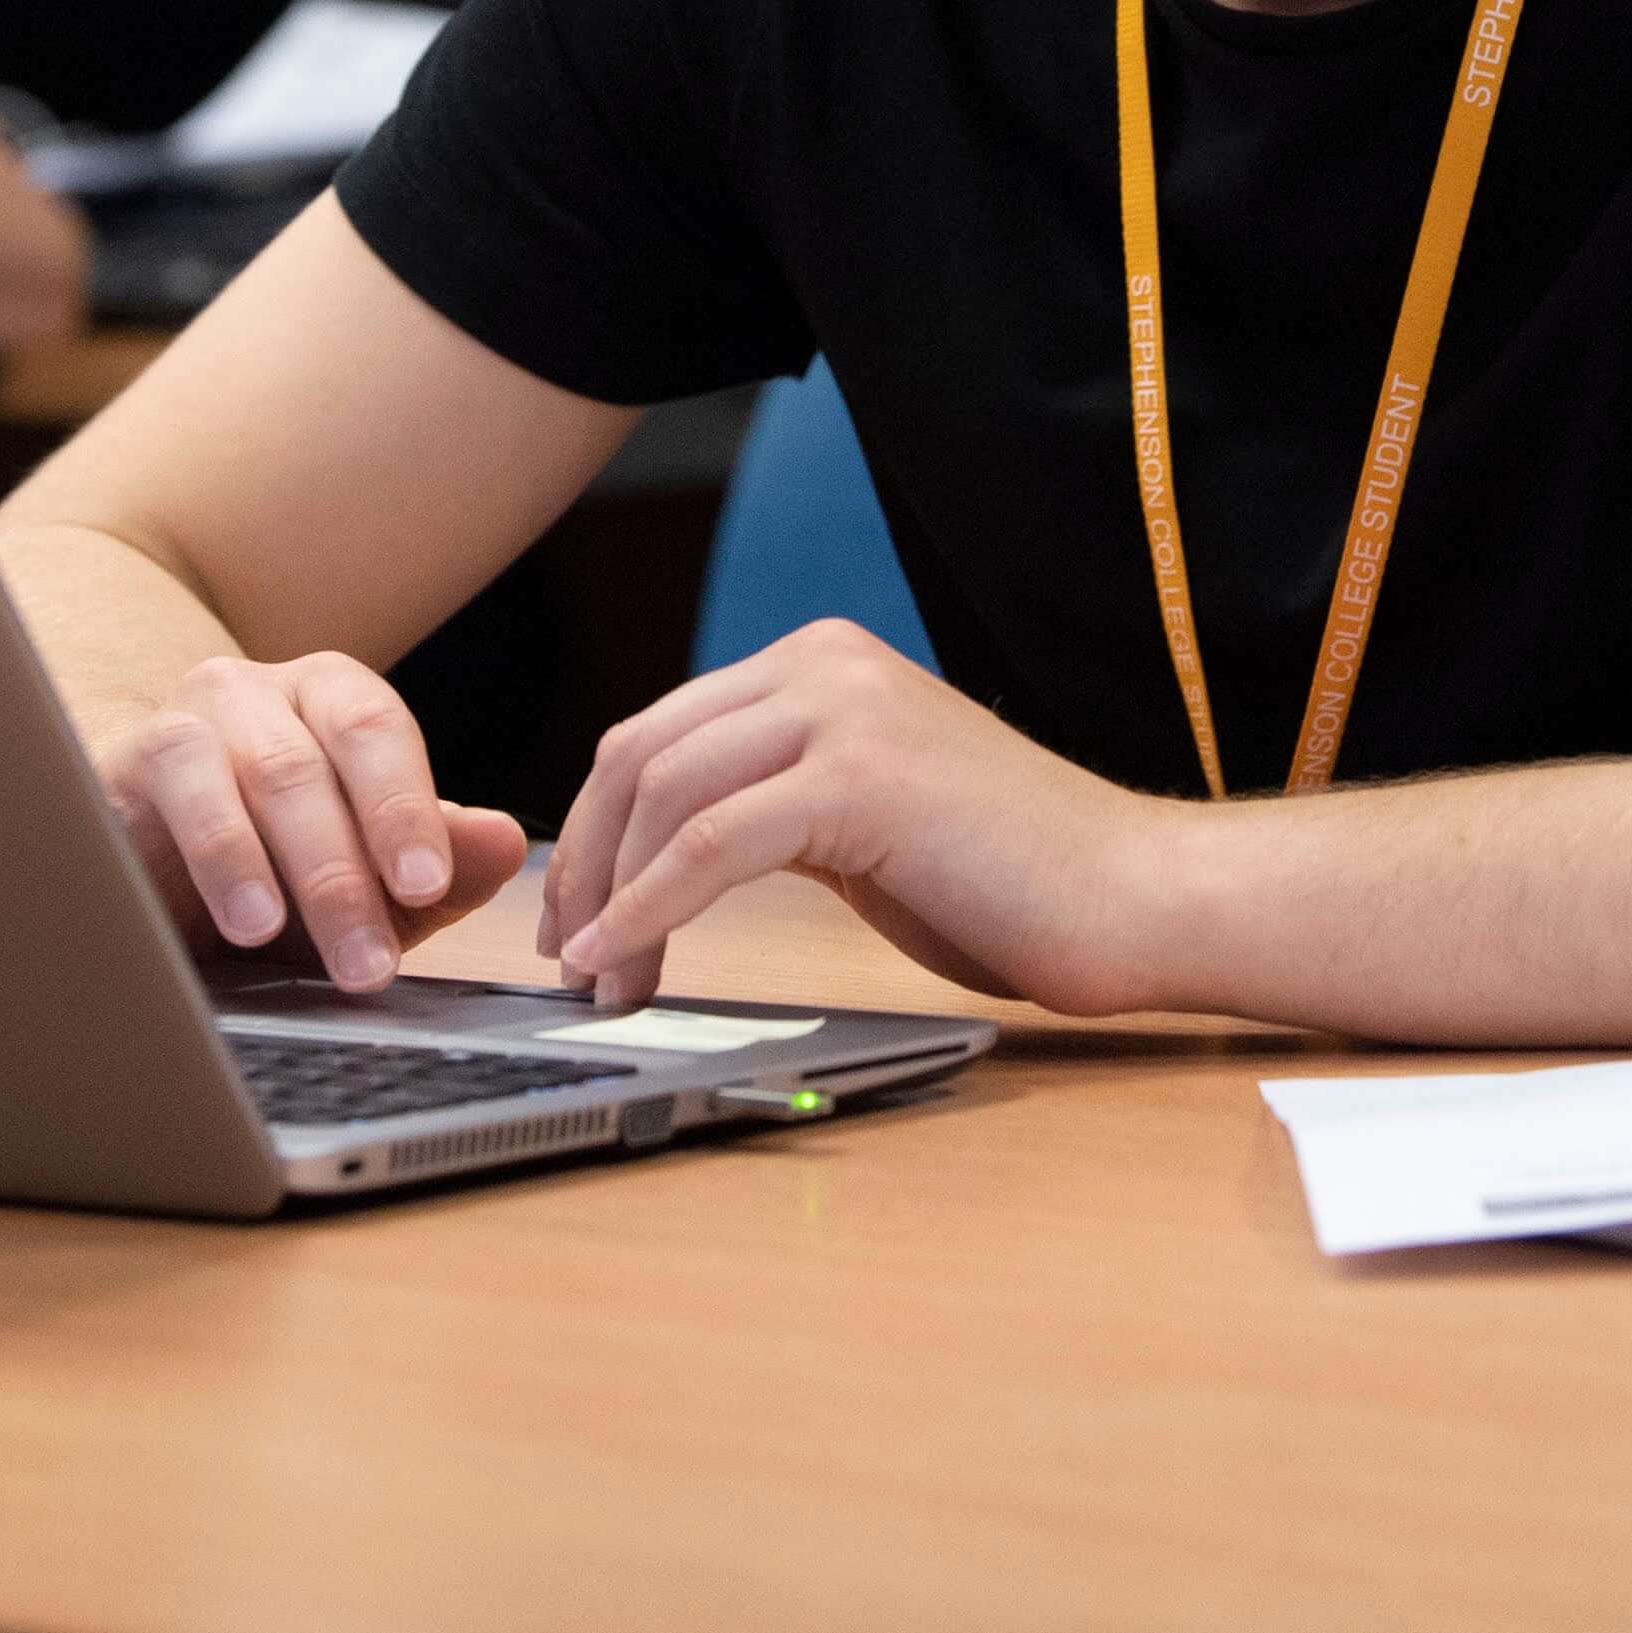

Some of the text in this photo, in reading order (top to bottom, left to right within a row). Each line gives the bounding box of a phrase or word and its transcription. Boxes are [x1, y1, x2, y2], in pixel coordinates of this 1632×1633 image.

[1130, 273, 1166, 509] STEPHENSON
[1150, 518, 1197, 674] COLLEGE
[1324, 536, 1384, 683] COLLEGE
[1359, 371, 1421, 532] STUDENT
